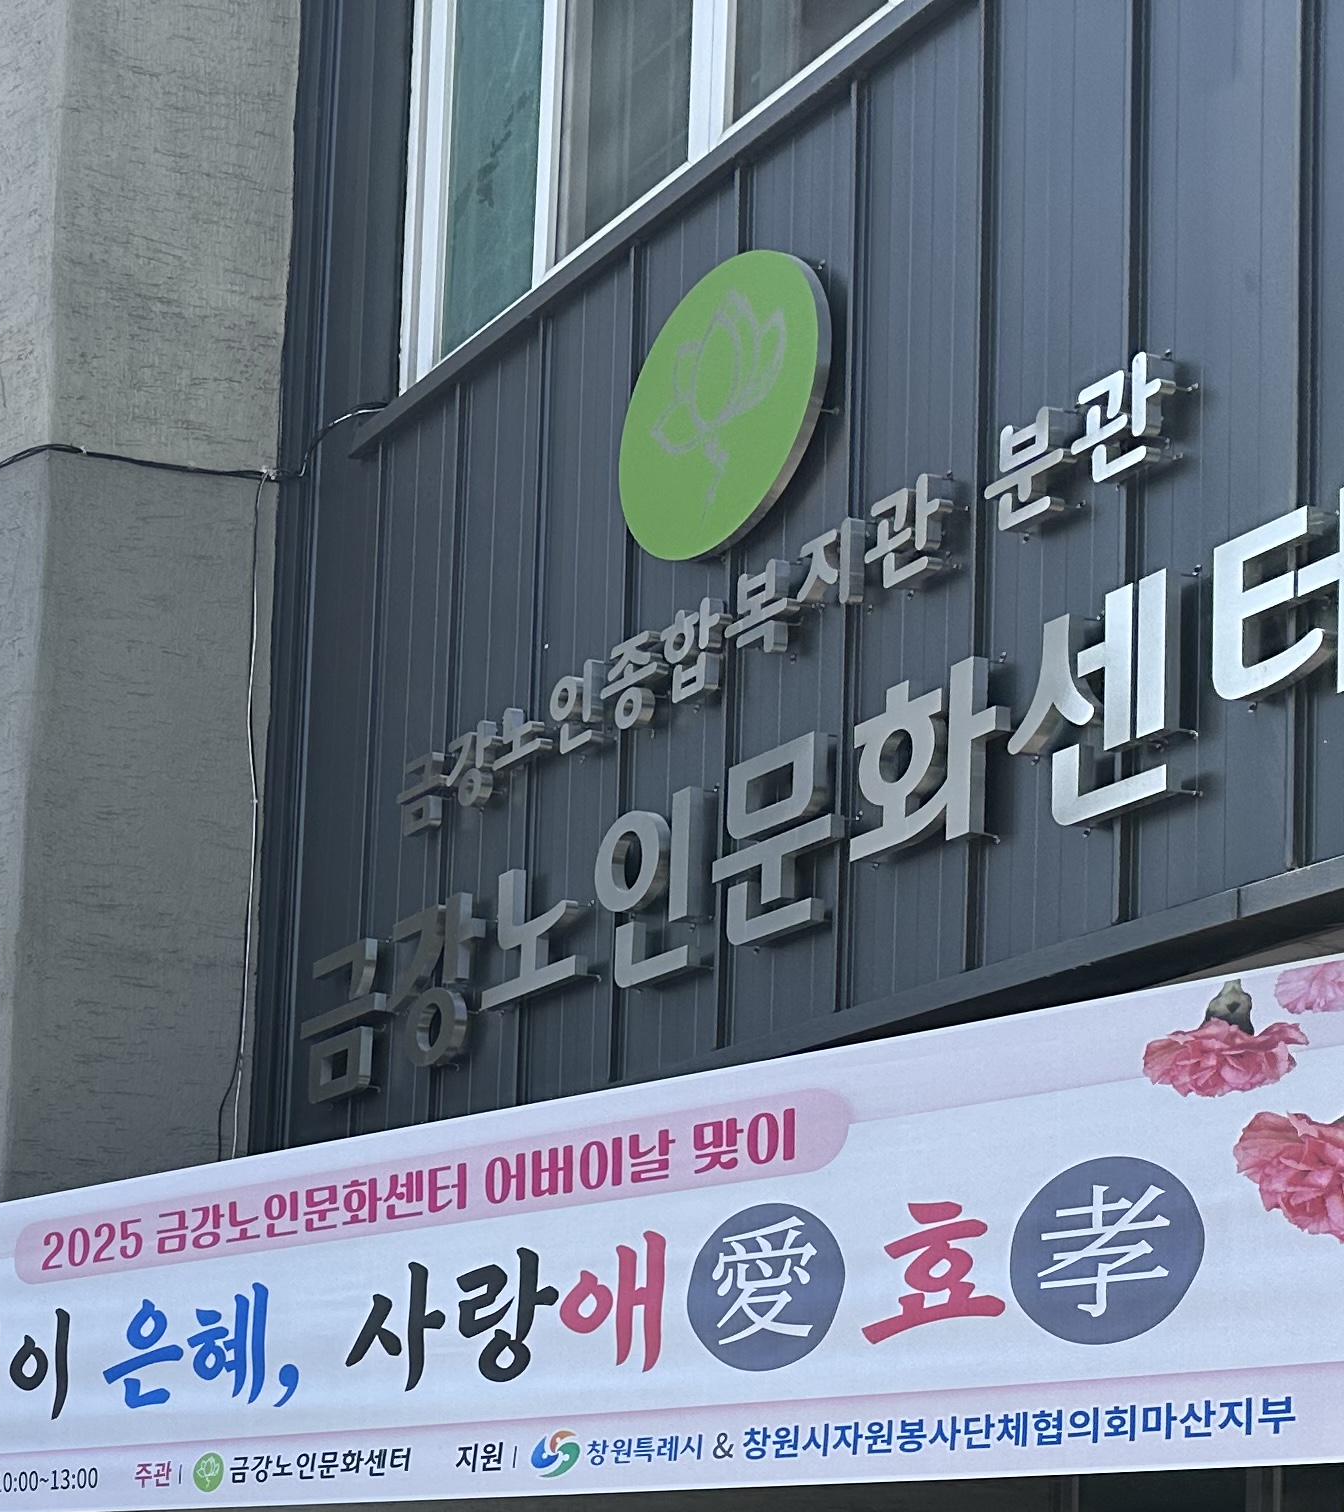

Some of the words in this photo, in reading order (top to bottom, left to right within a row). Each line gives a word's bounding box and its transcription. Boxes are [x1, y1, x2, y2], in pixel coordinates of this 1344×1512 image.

[397, 473, 957, 837] 금강노인종합복지관
[985, 351, 1178, 532] 분관
[301, 490, 1344, 1103] 금강노인문화센터
[42, 1219, 144, 1271] 2025
[156, 1164, 468, 1256] 금강노인문화센터
[484, 1121, 675, 1206] 어버이날
[692, 1108, 797, 1176] 맞이
[103, 1282, 300, 1409] 은혜,
[710, 1215, 819, 1348] 愛
[860, 1201, 1007, 1346] 효
[1036, 1183, 1173, 1319] 孝
[134, 1461, 173, 1488] 주관
[229, 1447, 413, 1484] 금강노인문화센터
[455, 1442, 504, 1473] 지원
[586, 1432, 704, 1467] 창원특례시
[713, 1434, 736, 1461] &
[743, 1396, 1298, 1462] 창원시자원봉사단체협의회마산지부
